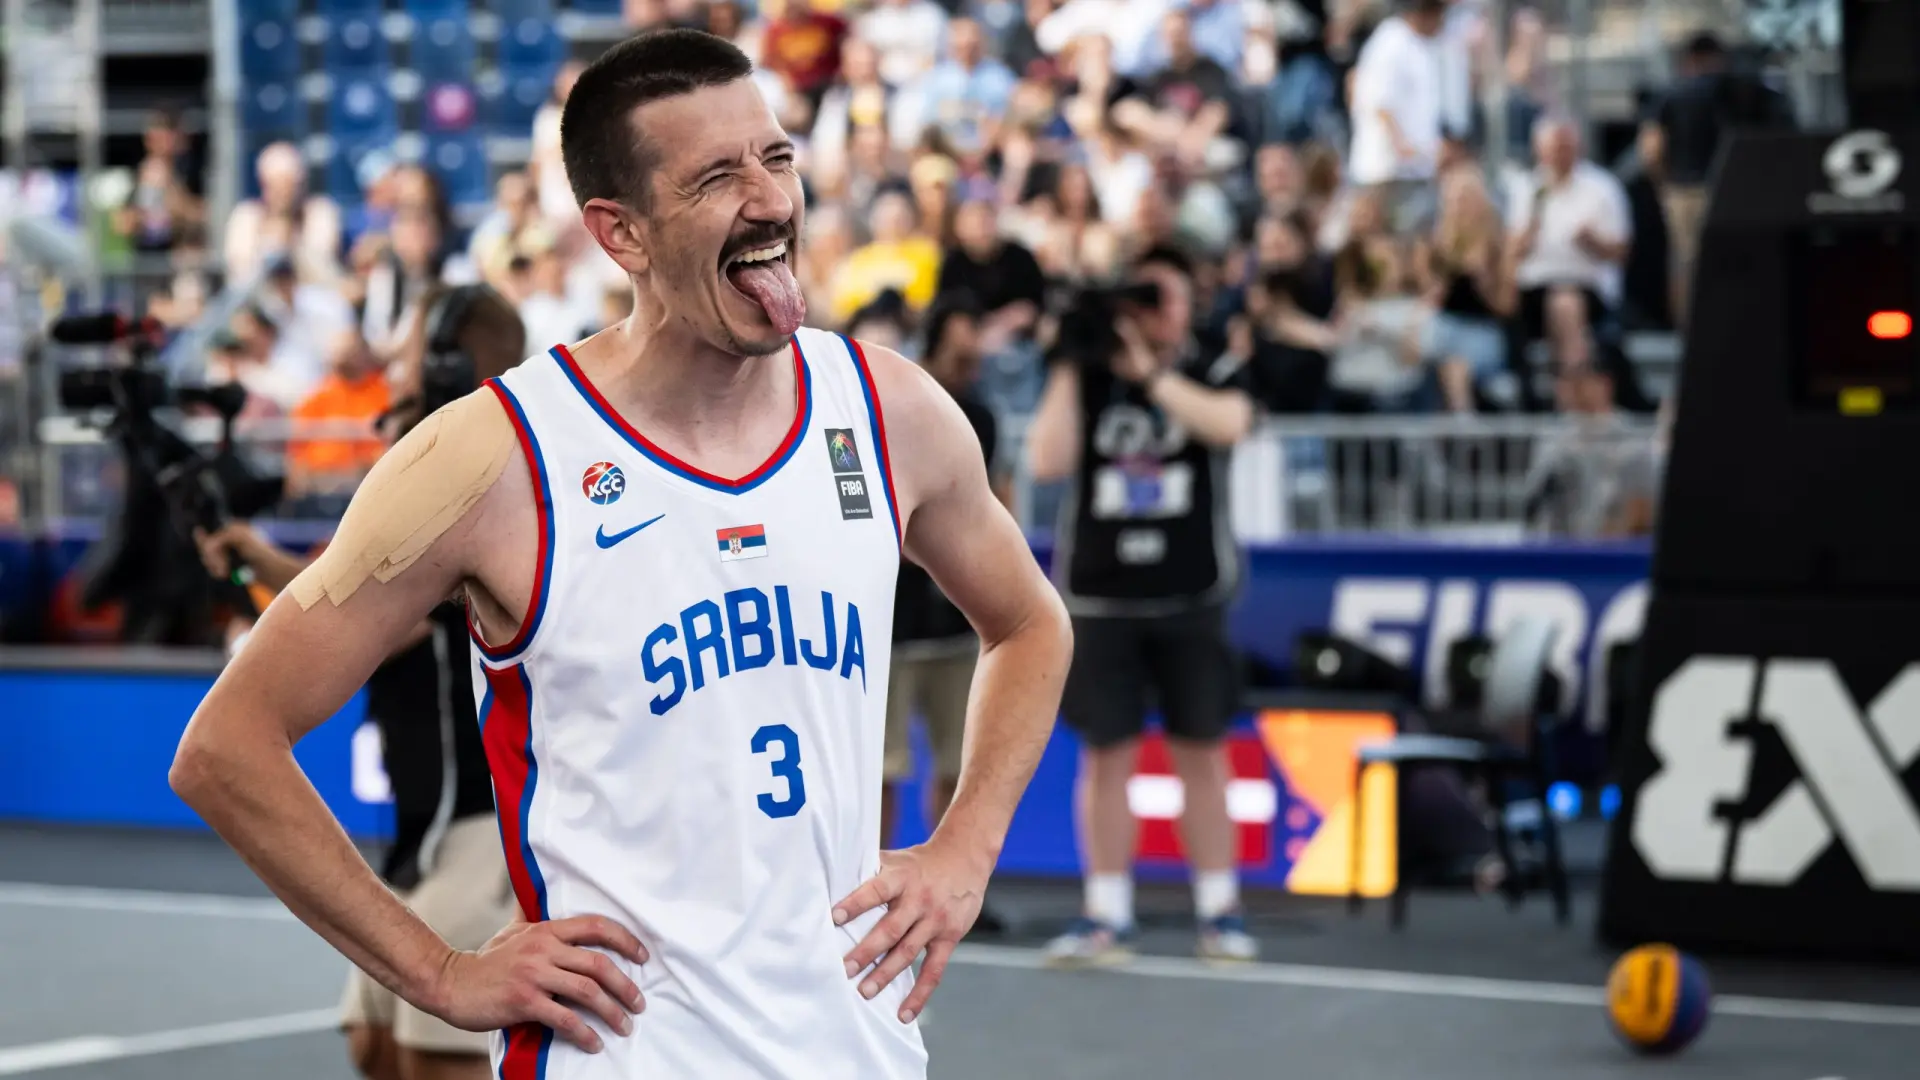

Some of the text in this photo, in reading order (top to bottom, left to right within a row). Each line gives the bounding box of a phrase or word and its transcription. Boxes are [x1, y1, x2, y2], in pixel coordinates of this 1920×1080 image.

[840, 480, 864, 496] FIBA
[639, 584, 867, 717] SRBIJA
[750, 723, 807, 820] 3
